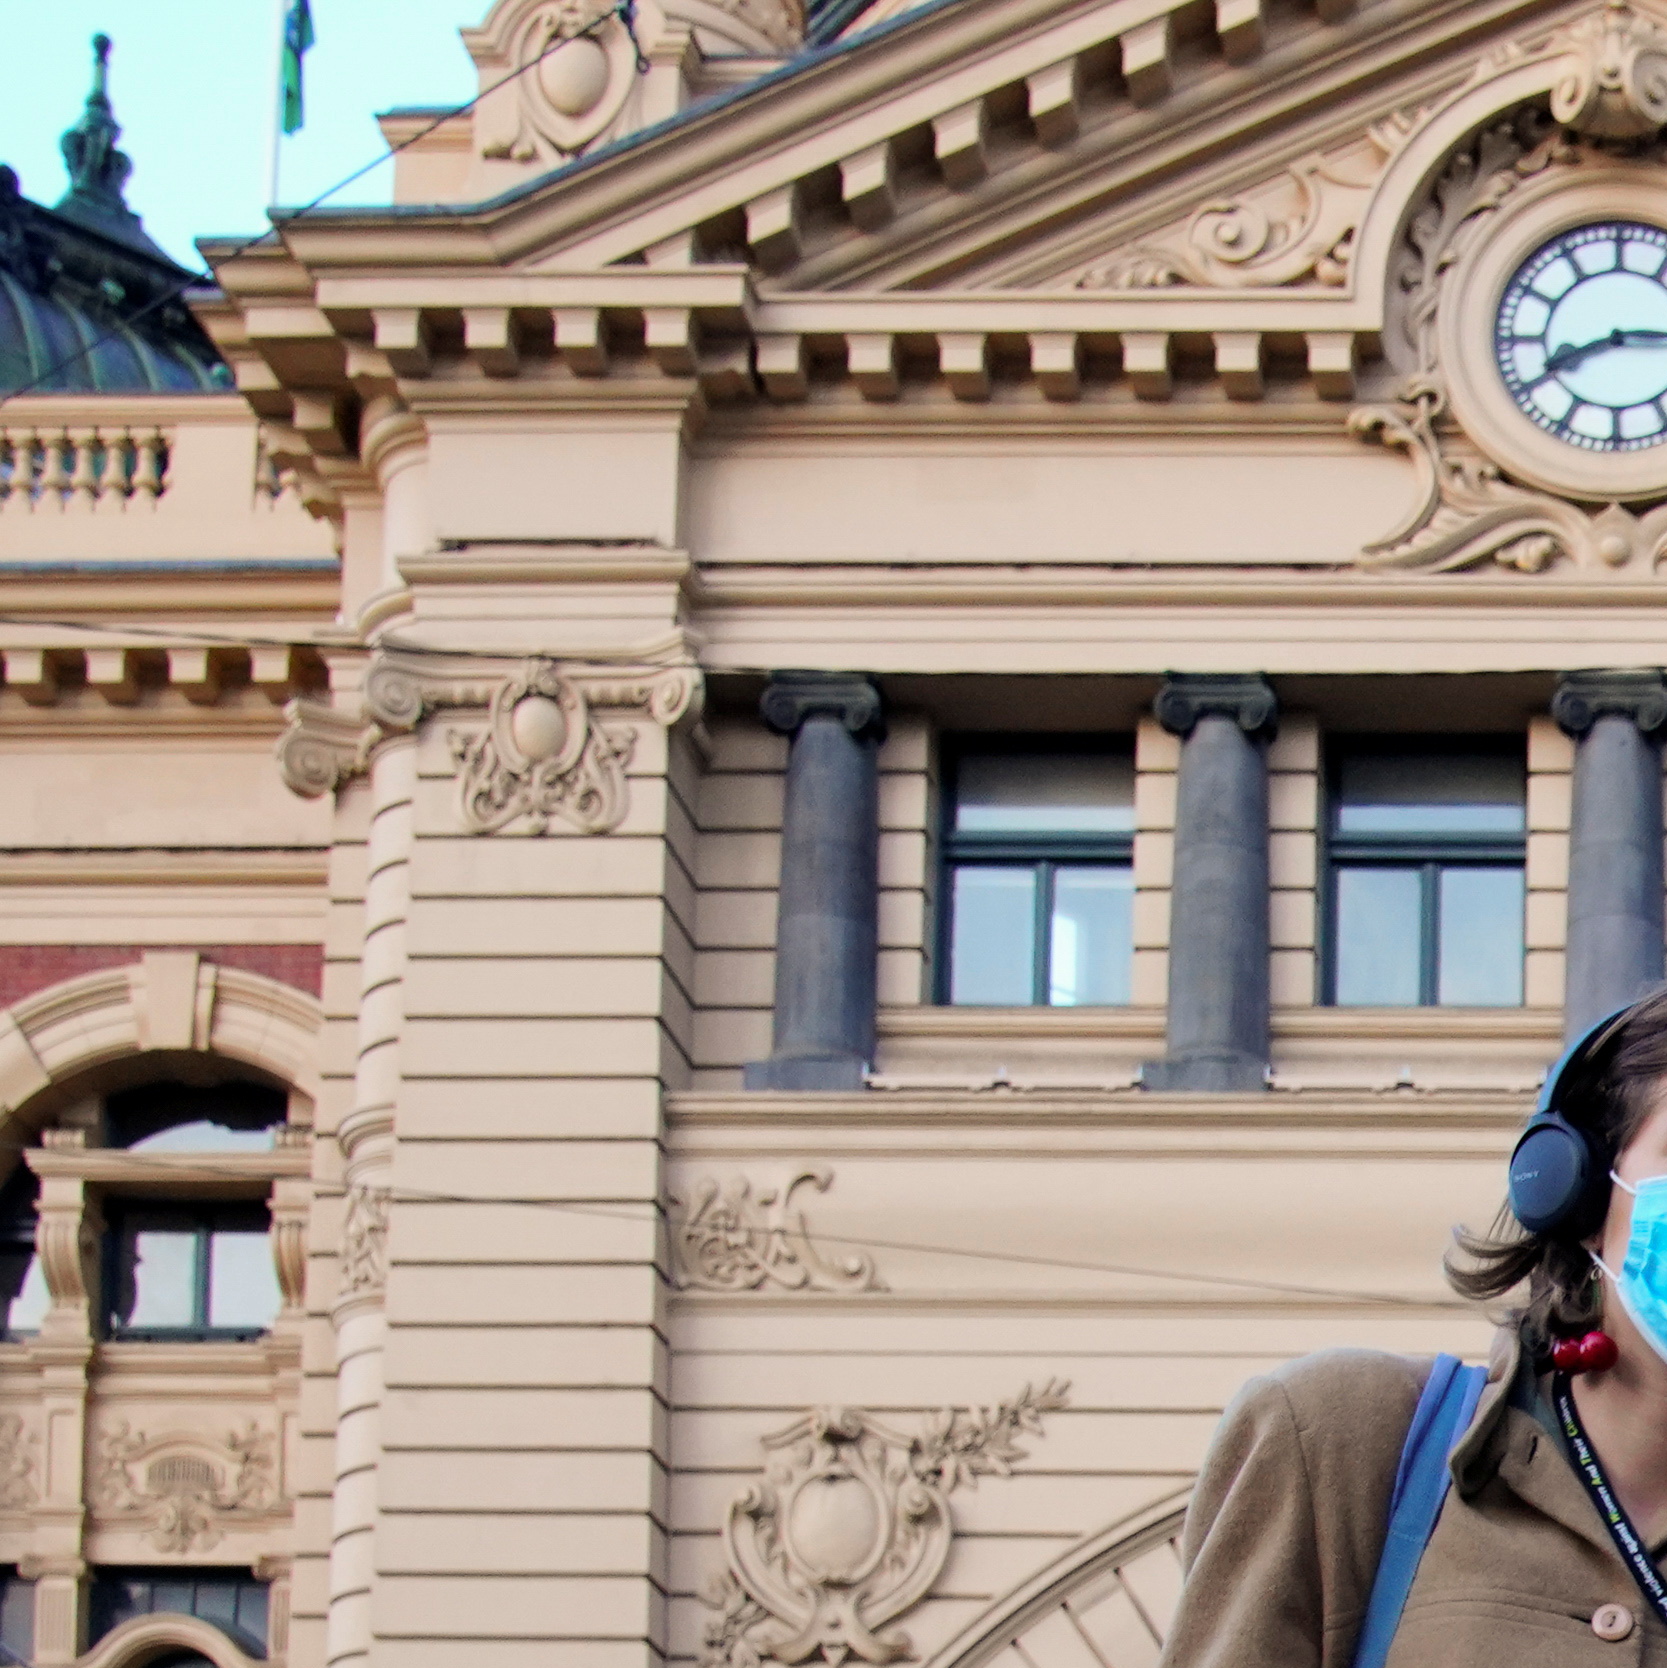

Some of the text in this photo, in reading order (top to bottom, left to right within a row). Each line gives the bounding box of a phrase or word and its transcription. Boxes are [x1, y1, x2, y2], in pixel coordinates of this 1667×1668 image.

[1597, 1486, 1621, 1524] Women
[1614, 1521, 1639, 1555] against
[1633, 1553, 1664, 1597] violence
